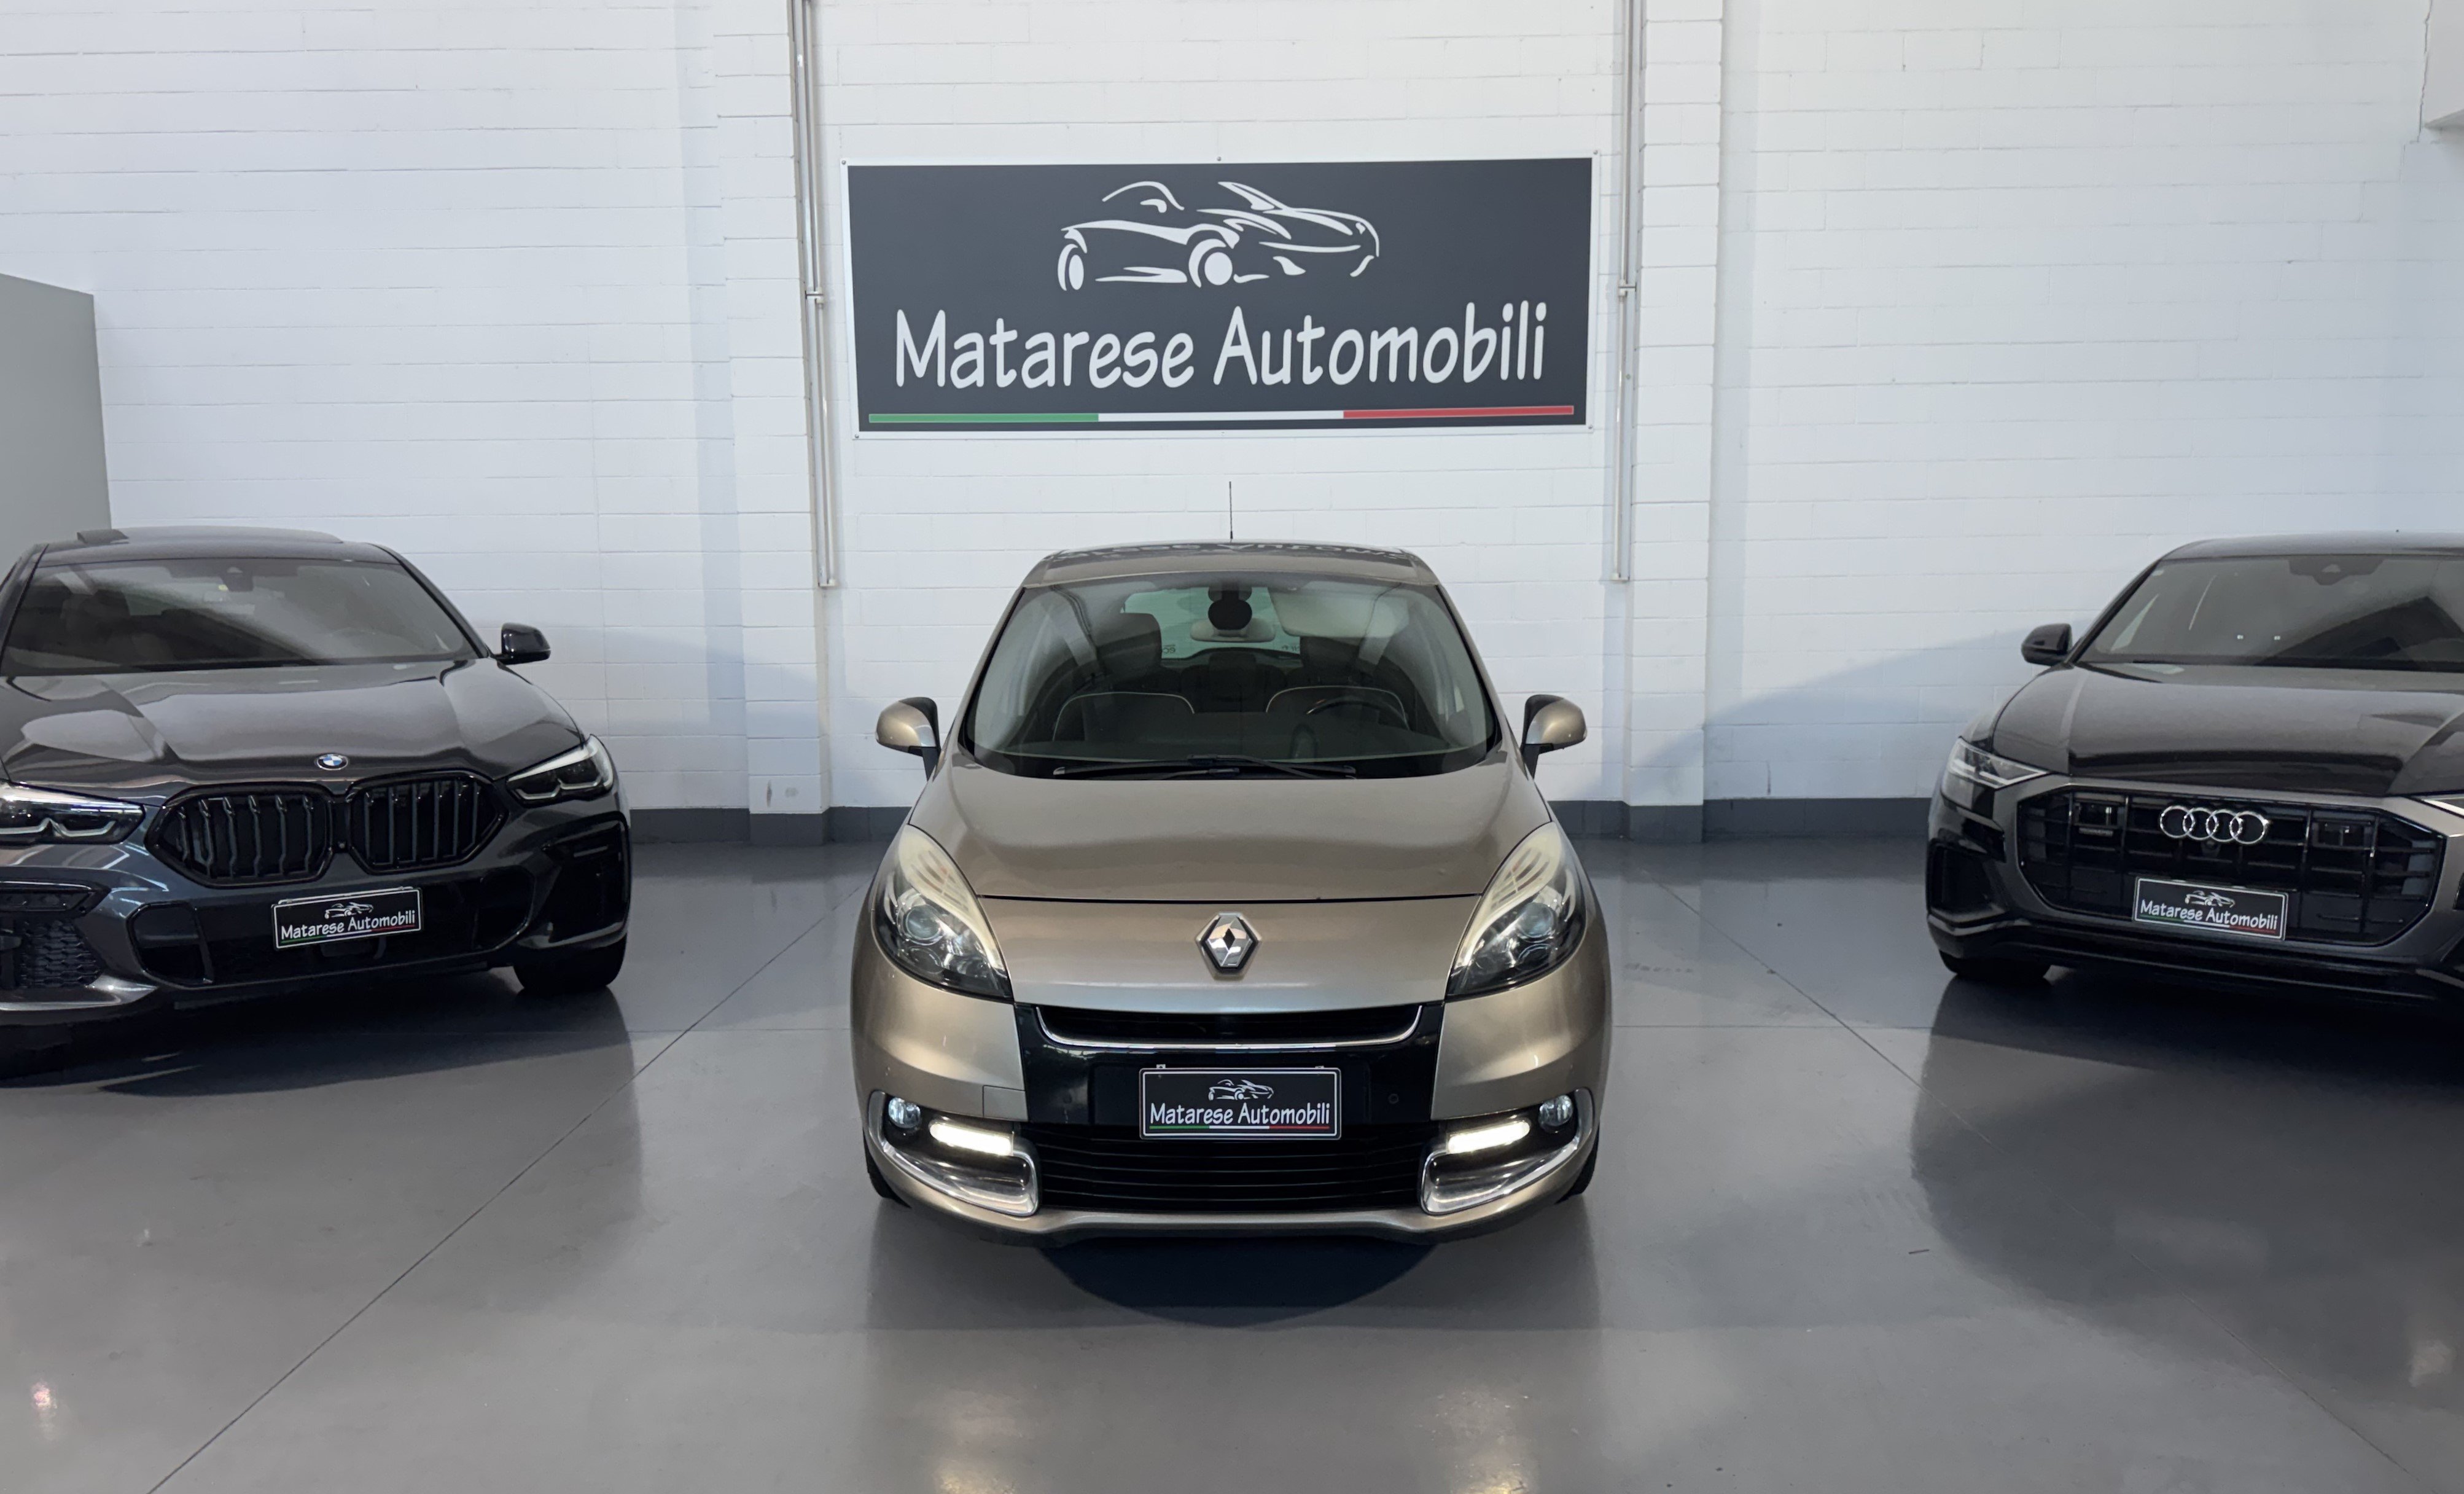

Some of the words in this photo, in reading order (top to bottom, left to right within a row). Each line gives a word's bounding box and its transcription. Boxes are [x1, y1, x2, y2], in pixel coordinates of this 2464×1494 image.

[896, 309, 1195, 389] Matarese
[1213, 300, 1547, 385] Automobili
[281, 922, 345, 940] Matarese
[348, 910, 416, 931] Automobili
[2140, 899, 2203, 921] Matarese
[2205, 907, 2278, 930] Automobili
[1150, 1103, 1234, 1125] Matarese
[1238, 1102, 1330, 1125] Automobili
